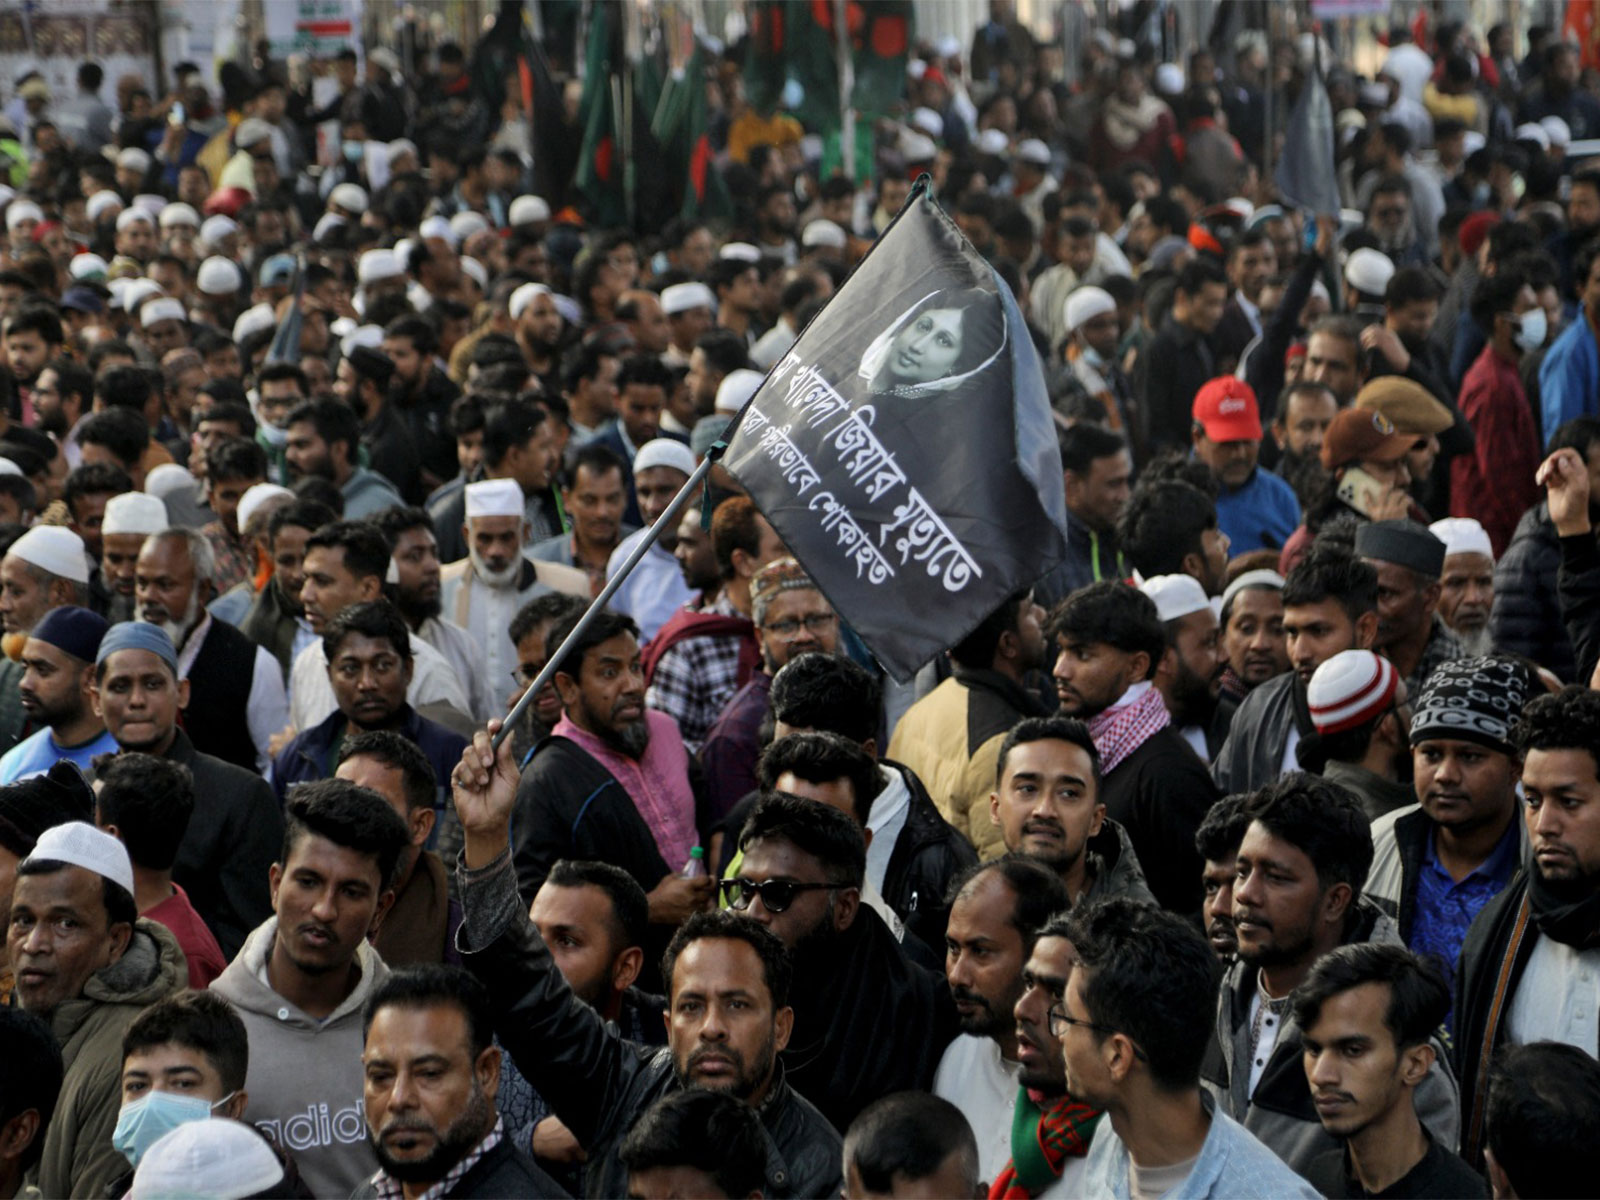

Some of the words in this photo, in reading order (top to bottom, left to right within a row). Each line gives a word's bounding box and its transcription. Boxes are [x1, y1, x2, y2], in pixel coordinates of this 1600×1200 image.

[761, 424, 822, 497] গভীরভাবে
[808, 491, 896, 585] শোকাহত
[783, 364, 852, 430] খালেদা
[822, 404, 907, 504] জিয়ার
[879, 486, 983, 592] মৃত্যুতে
[1411, 709, 1509, 736] UCC
[254, 1099, 367, 1151] adid
